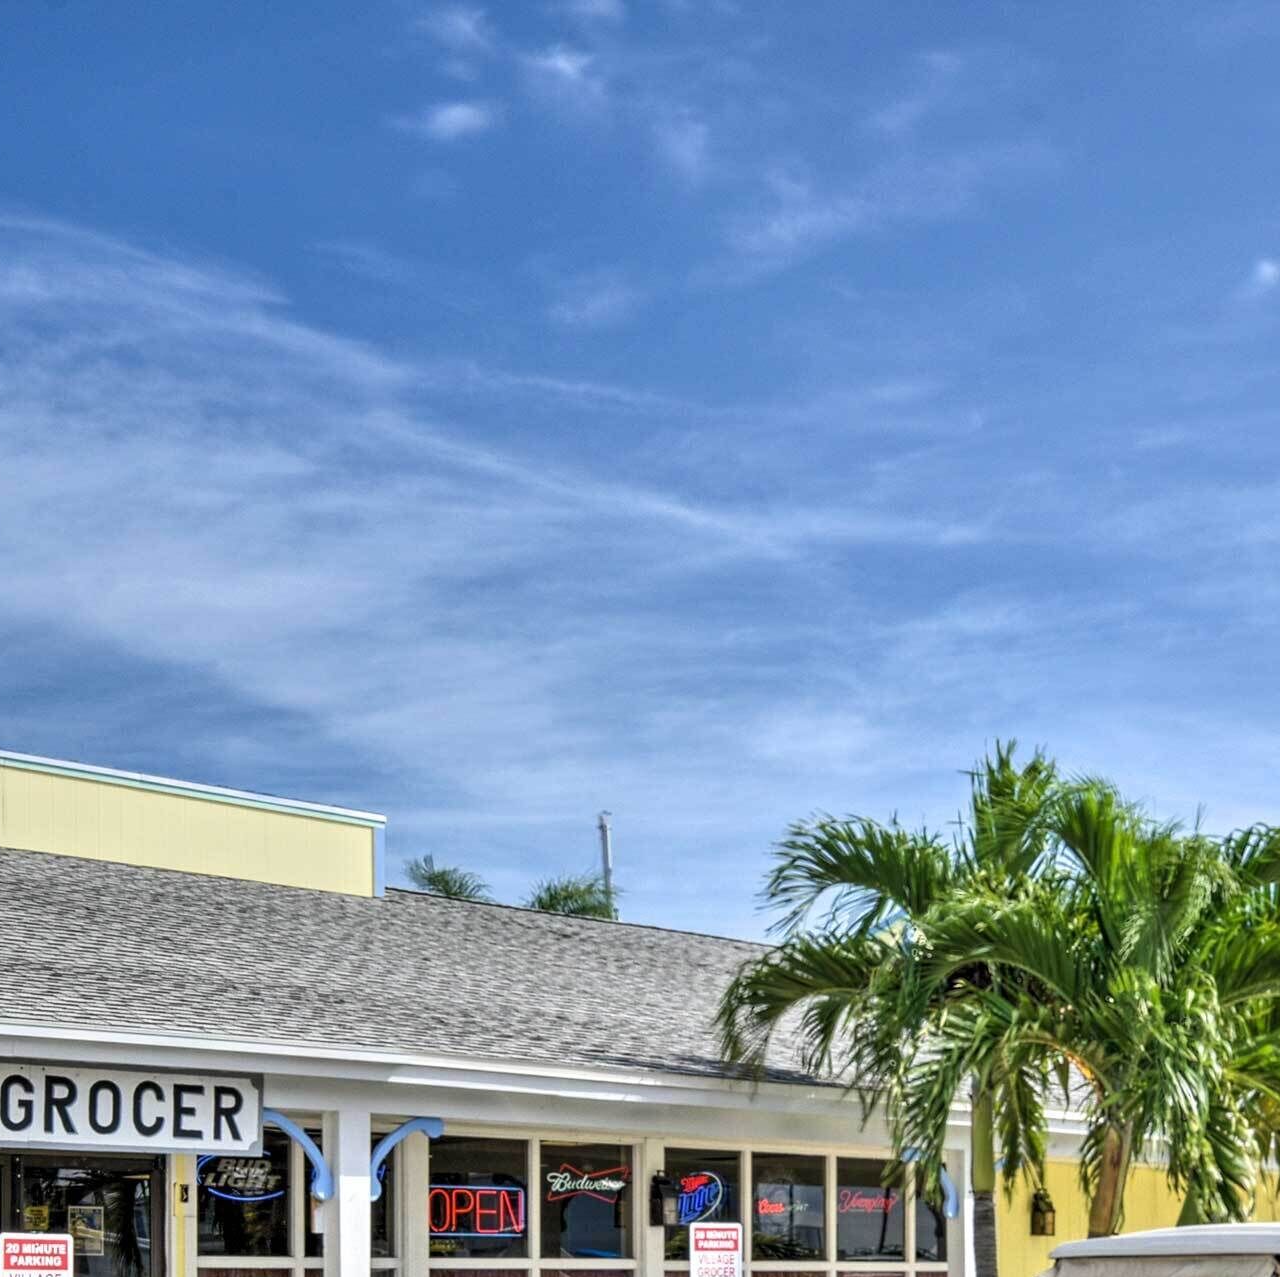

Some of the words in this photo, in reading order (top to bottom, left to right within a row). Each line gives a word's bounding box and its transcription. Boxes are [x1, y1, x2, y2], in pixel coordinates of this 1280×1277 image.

[0, 1074, 244, 1142] GROCER
[217, 1159, 272, 1173] BUD
[203, 1172, 282, 1190] LIGHT
[429, 1188, 524, 1233] OPEN
[5, 1243, 18, 1254] 20
[22, 1243, 67, 1255] MINUTE
[698, 1241, 735, 1249] PARKING
[10, 1256, 62, 1266] PARKING
[699, 1254, 735, 1264] VILLAGE
[698, 1267, 736, 1277] GROCER
